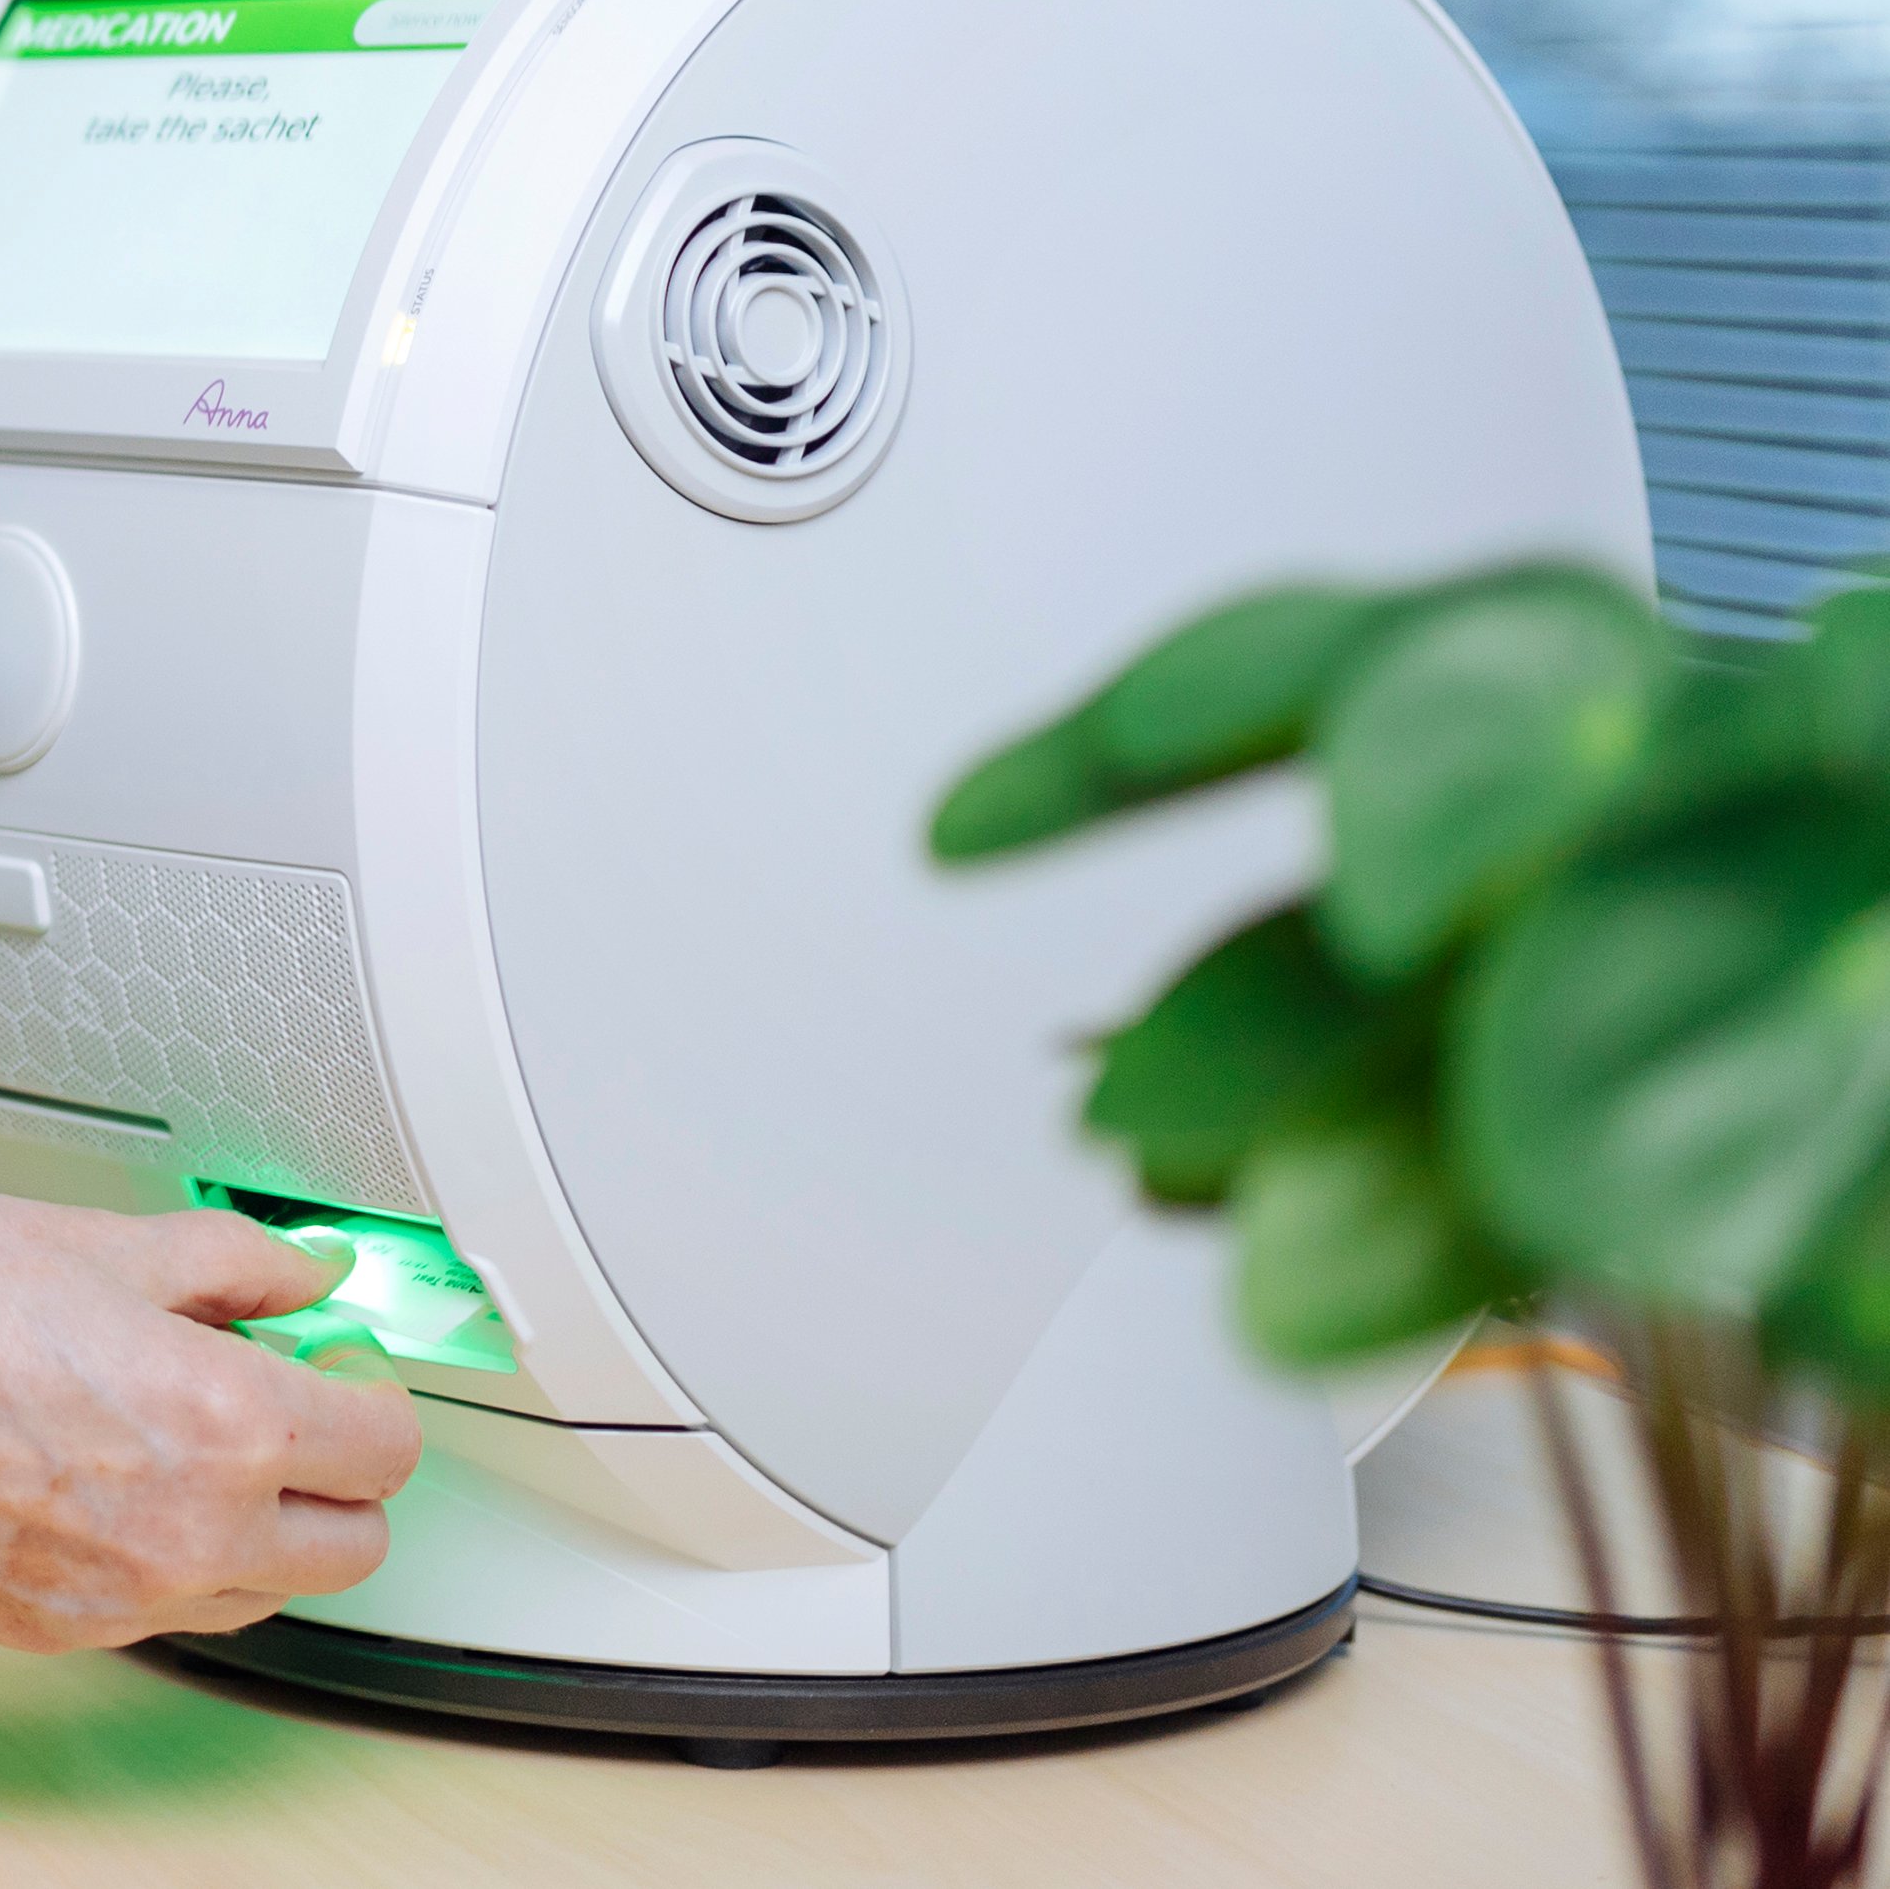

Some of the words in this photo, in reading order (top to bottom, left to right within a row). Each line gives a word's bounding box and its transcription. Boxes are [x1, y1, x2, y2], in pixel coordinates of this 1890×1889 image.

[13, 11, 237, 48] MEDICATION
[169, 71, 269, 102] Please,
[84, 114, 148, 143] take
[155, 112, 207, 142] the
[212, 110, 320, 142] sachet
[411, 269, 434, 315] STATUS
[183, 378, 269, 430] Anna
